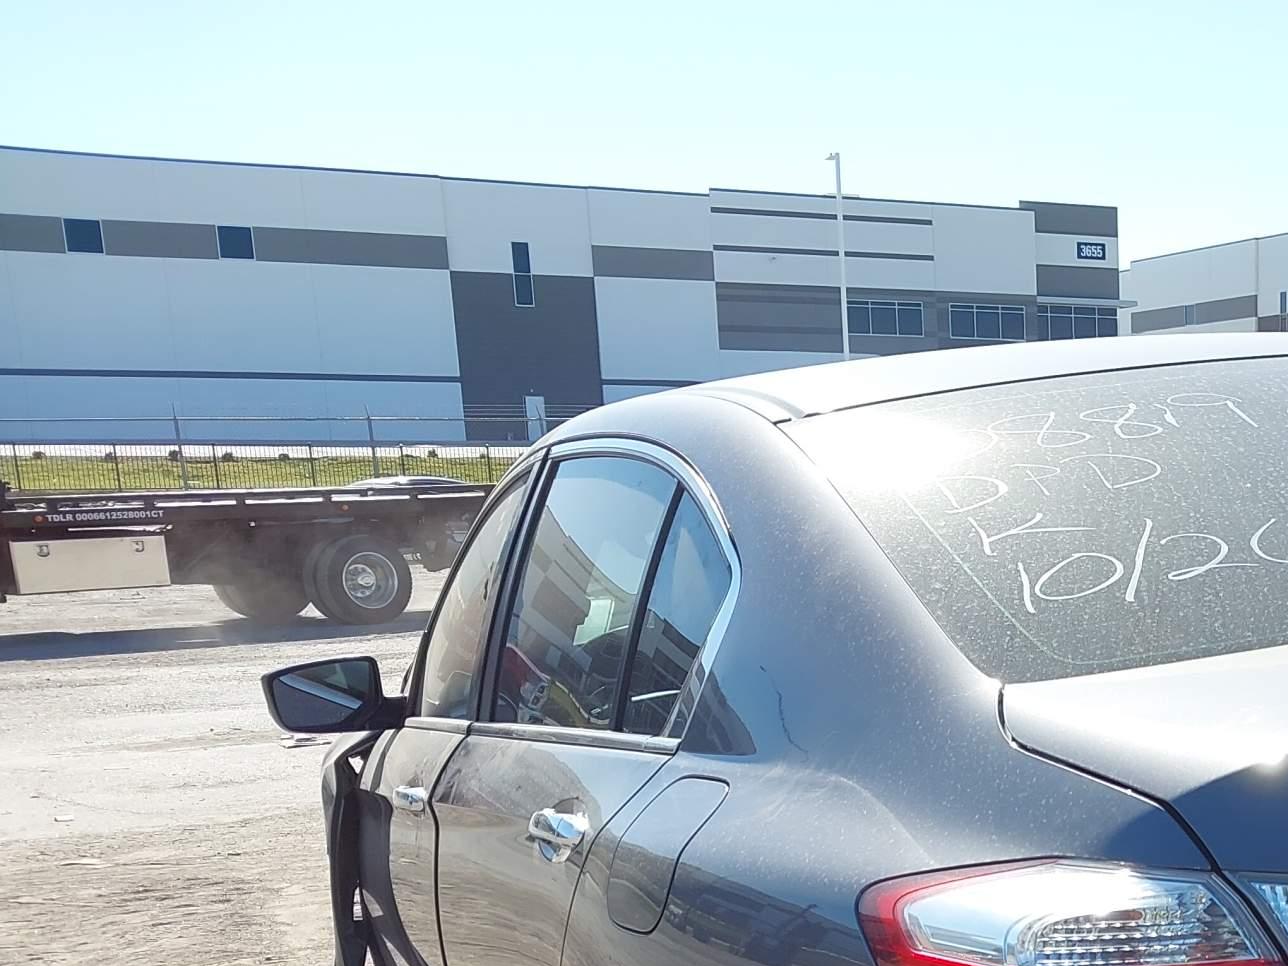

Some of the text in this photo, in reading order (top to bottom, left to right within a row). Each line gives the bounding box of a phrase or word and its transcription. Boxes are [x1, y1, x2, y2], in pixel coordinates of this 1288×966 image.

[1080, 244, 1103, 258] 3655
[936, 453, 1162, 514] DPD
[46, 512, 74, 522] TDLR
